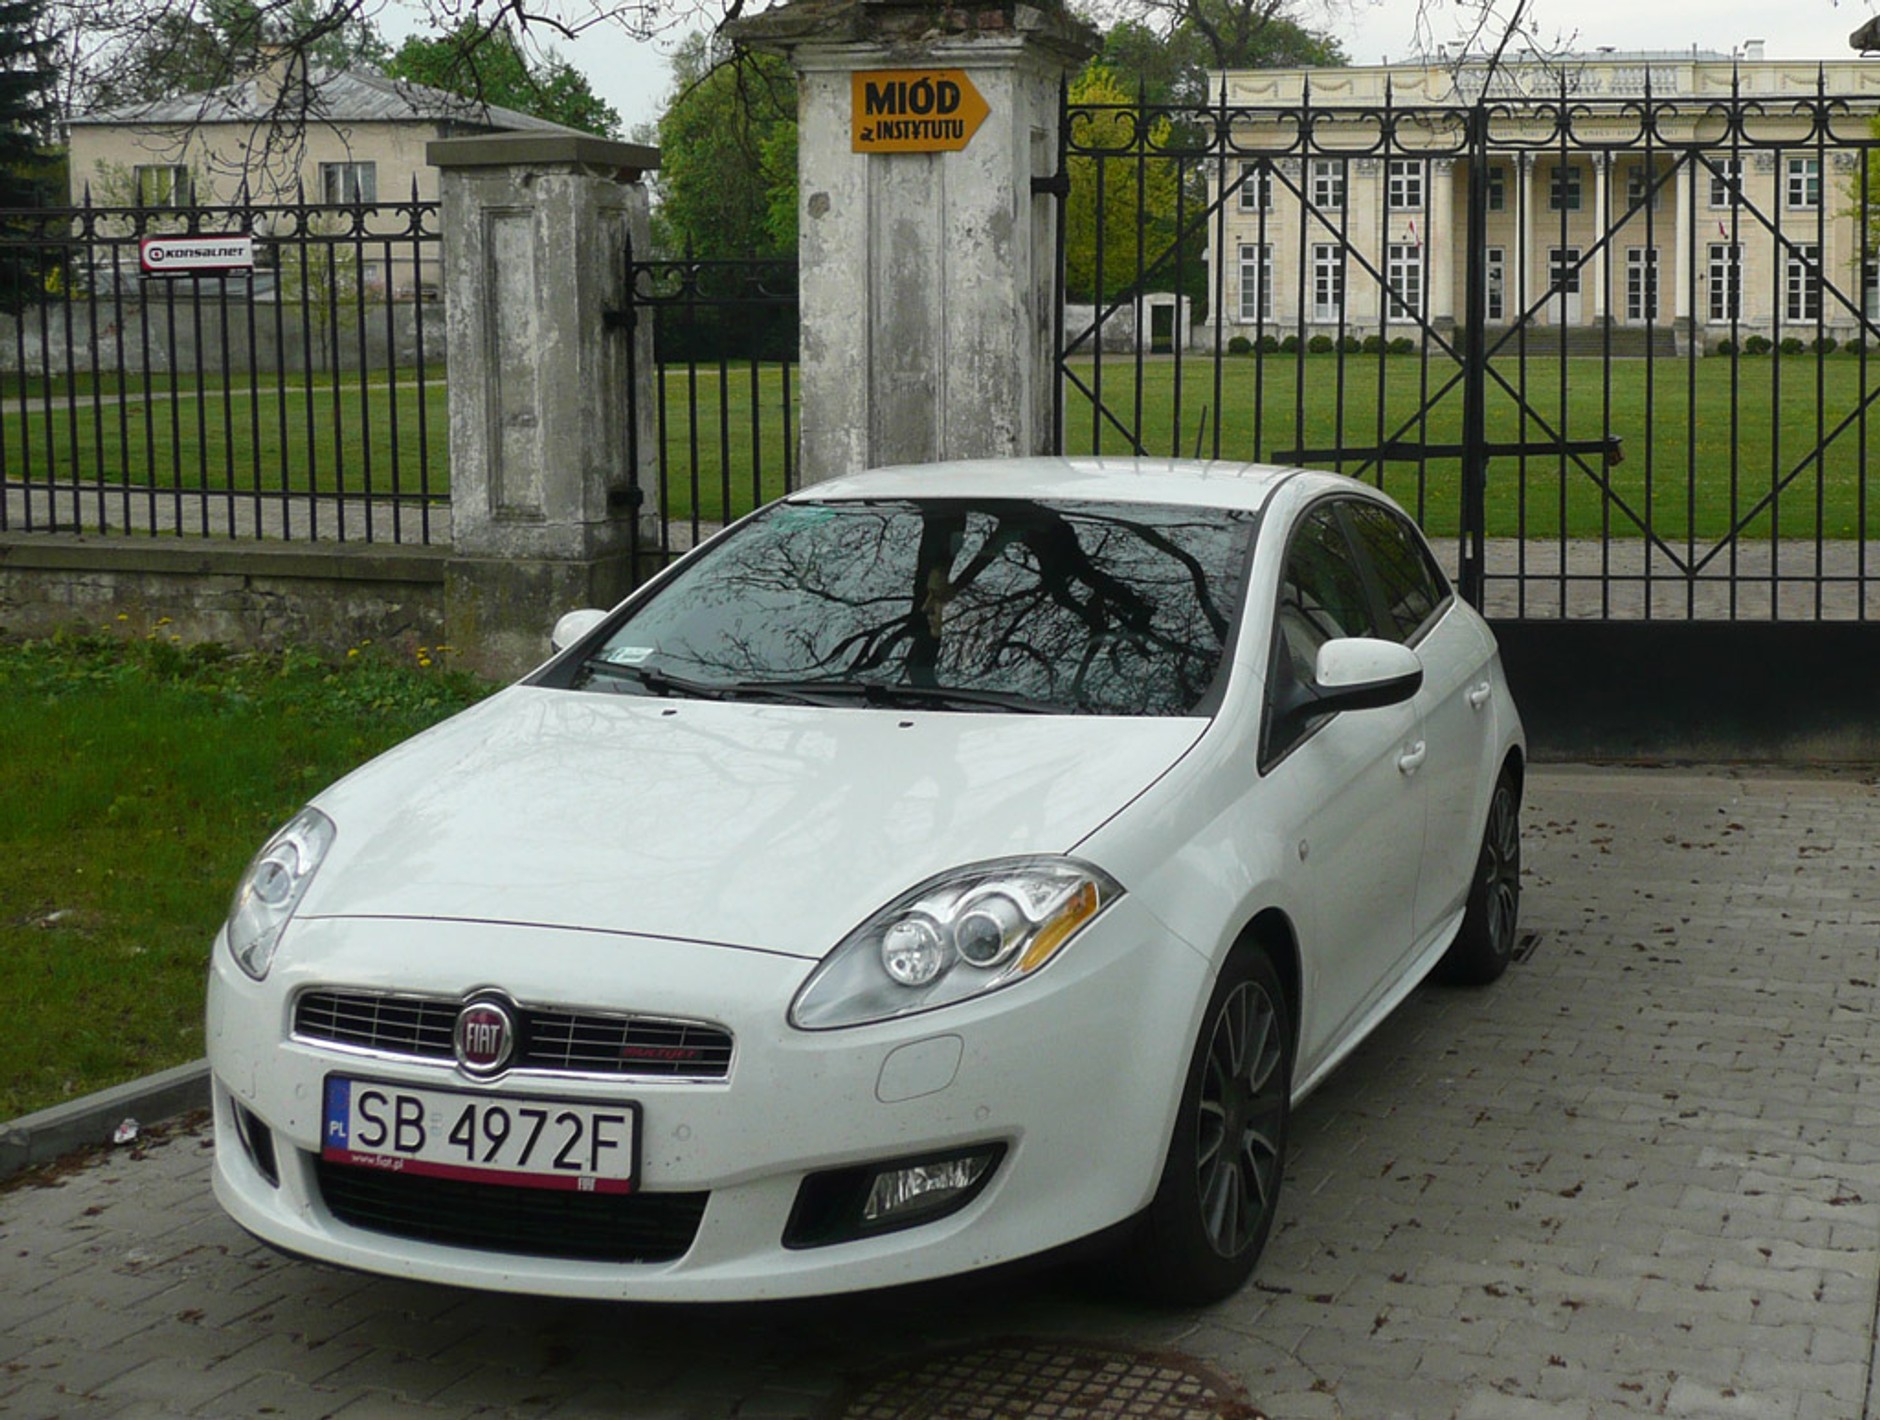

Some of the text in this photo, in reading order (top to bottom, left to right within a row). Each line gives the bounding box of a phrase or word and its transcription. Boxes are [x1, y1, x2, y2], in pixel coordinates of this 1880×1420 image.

[866, 77, 961, 115] MIÓD
[876, 119, 964, 140] INSTYTUTU
[466, 1022, 501, 1054] FIAT
[329, 1120, 346, 1138] PL
[357, 1090, 625, 1172] SB 4972F
